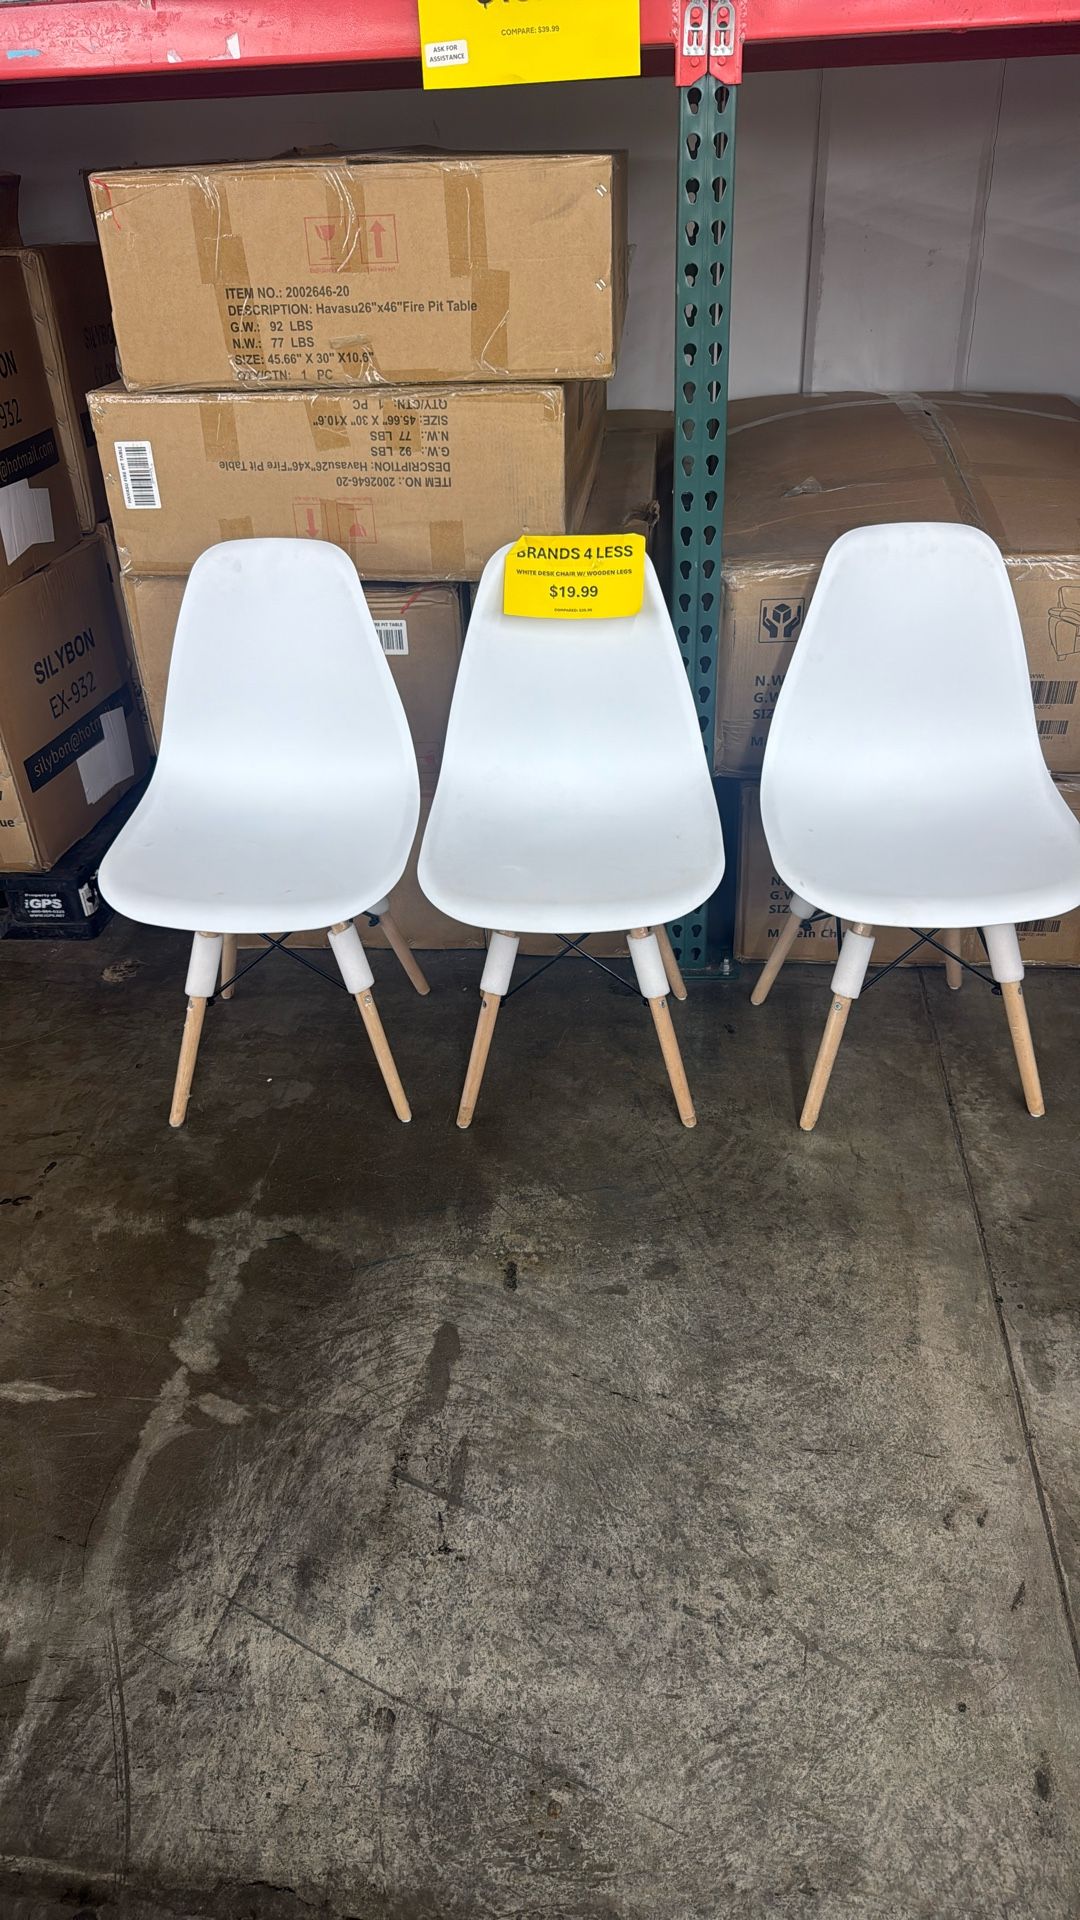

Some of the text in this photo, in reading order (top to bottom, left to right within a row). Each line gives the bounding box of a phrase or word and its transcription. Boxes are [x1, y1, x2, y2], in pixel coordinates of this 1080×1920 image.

[501, 25, 560, 36] COMPARE: $39.99
[433, 44, 458, 53] ASK FOR
[429, 53, 465, 63] ASSISTANCE
[225, 285, 349, 300] ITEM NO.: 2002646-20
[228, 304, 313, 317] DESCRIPTION:
[428, 301, 444, 313] Pit
[447, 300, 477, 312] Table
[230, 321, 313, 332] G.W.: 92 LBS
[233, 337, 314, 349] N.W.: 77 LBS
[0, 350, 18, 378] ON
[234, 352, 374, 365] SIZE: 45.66" X 30" X10.6"
[302, 370, 306, 380] 1
[317, 369, 333, 380] PC
[353, 400, 368, 409] PC
[379, 400, 383, 409] 1
[0, 398, 22, 429] 932
[313, 415, 448, 426] SIZE: 45.66" X 30" X10.6"
[370, 431, 449, 441] N.W.: 77 LBS
[371, 447, 449, 457] G.W.: 92 LBS
[0, 440, 54, 483] @hotmail.com
[219, 461, 247, 471] Table
[251, 461, 264, 471] Pit
[371, 462, 450, 472] DESCRIPTION:
[336, 477, 452, 487] ITEM NO.: 2002646-20
[517, 545, 633, 560] BRANDS 4 LESS
[549, 585, 598, 599] $19.99
[34, 628, 96, 684] SILYBON
[755, 675, 785, 686] N.W
[49, 671, 97, 720] EX-932
[754, 692, 780, 703] G.W
[752, 708, 774, 720] SIZ
[0, 820, 15, 828] ue
[770, 891, 794, 900] G.W
[24, 898, 62, 909] iGPS
[769, 905, 792, 914] SIZ
